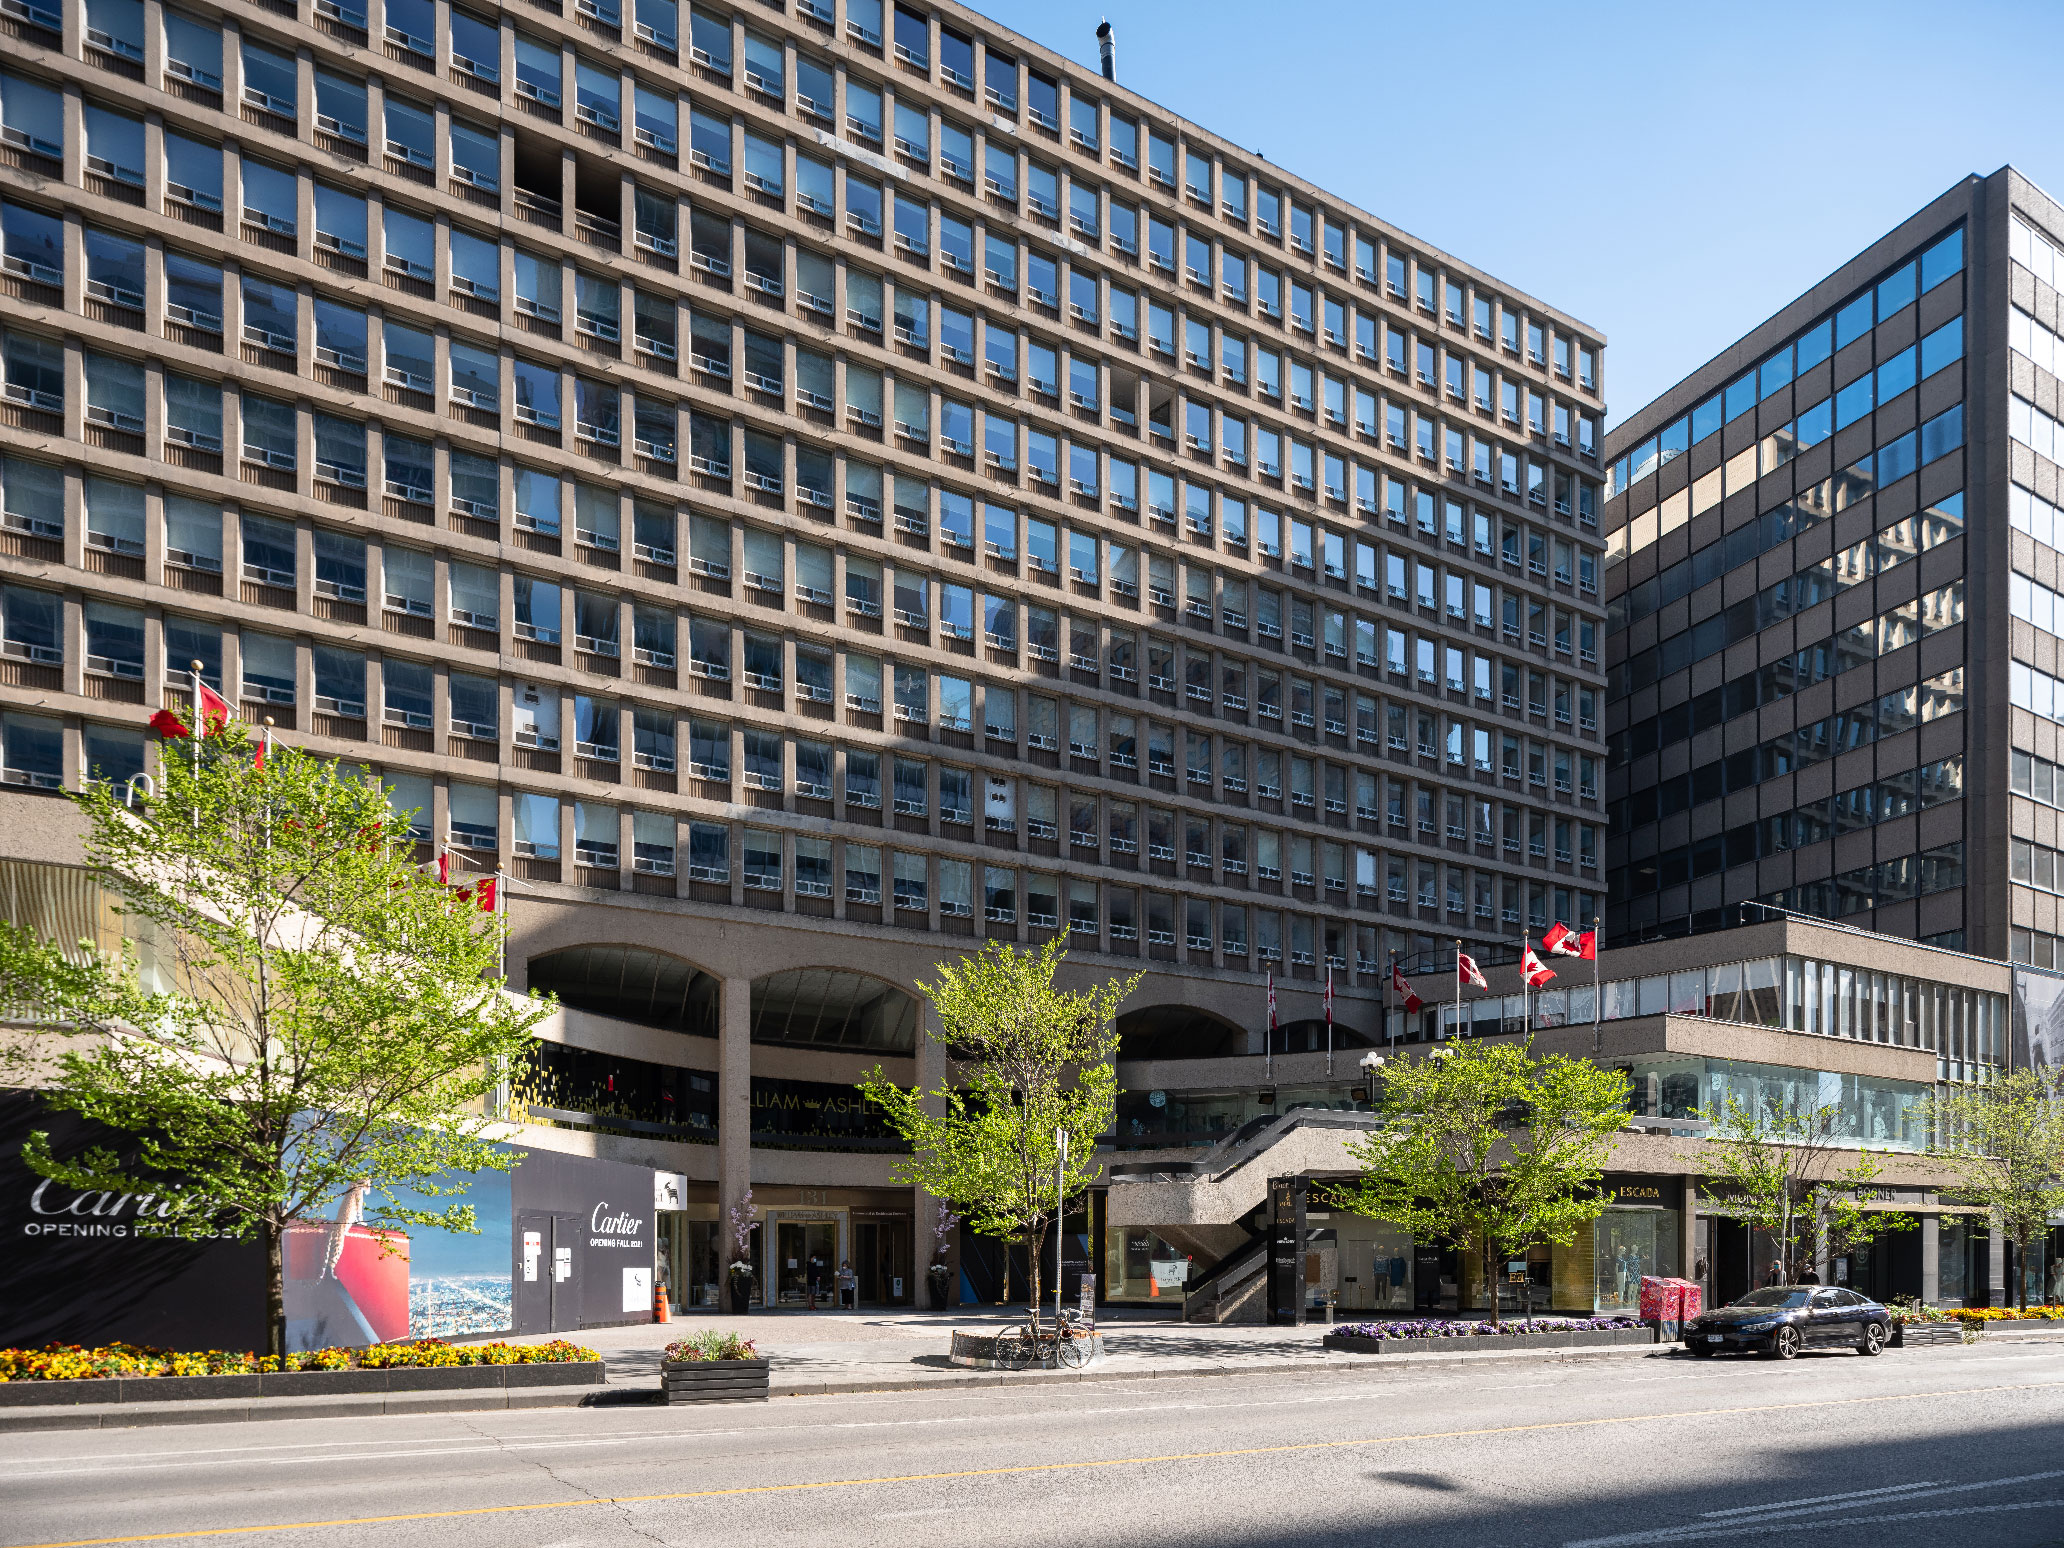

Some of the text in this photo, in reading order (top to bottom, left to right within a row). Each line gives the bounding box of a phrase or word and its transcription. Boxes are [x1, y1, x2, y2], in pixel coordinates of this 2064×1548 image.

[750, 1090, 800, 1110] LIAM
[799, 1190, 827, 1205] 131
[1620, 1186, 1660, 1198] ESCADA
[591, 1201, 643, 1235] Cartier
[24, 1223, 127, 1238] OPENING
[590, 1238, 616, 1248] OPENING
[617, 1239, 630, 1248] FALL
